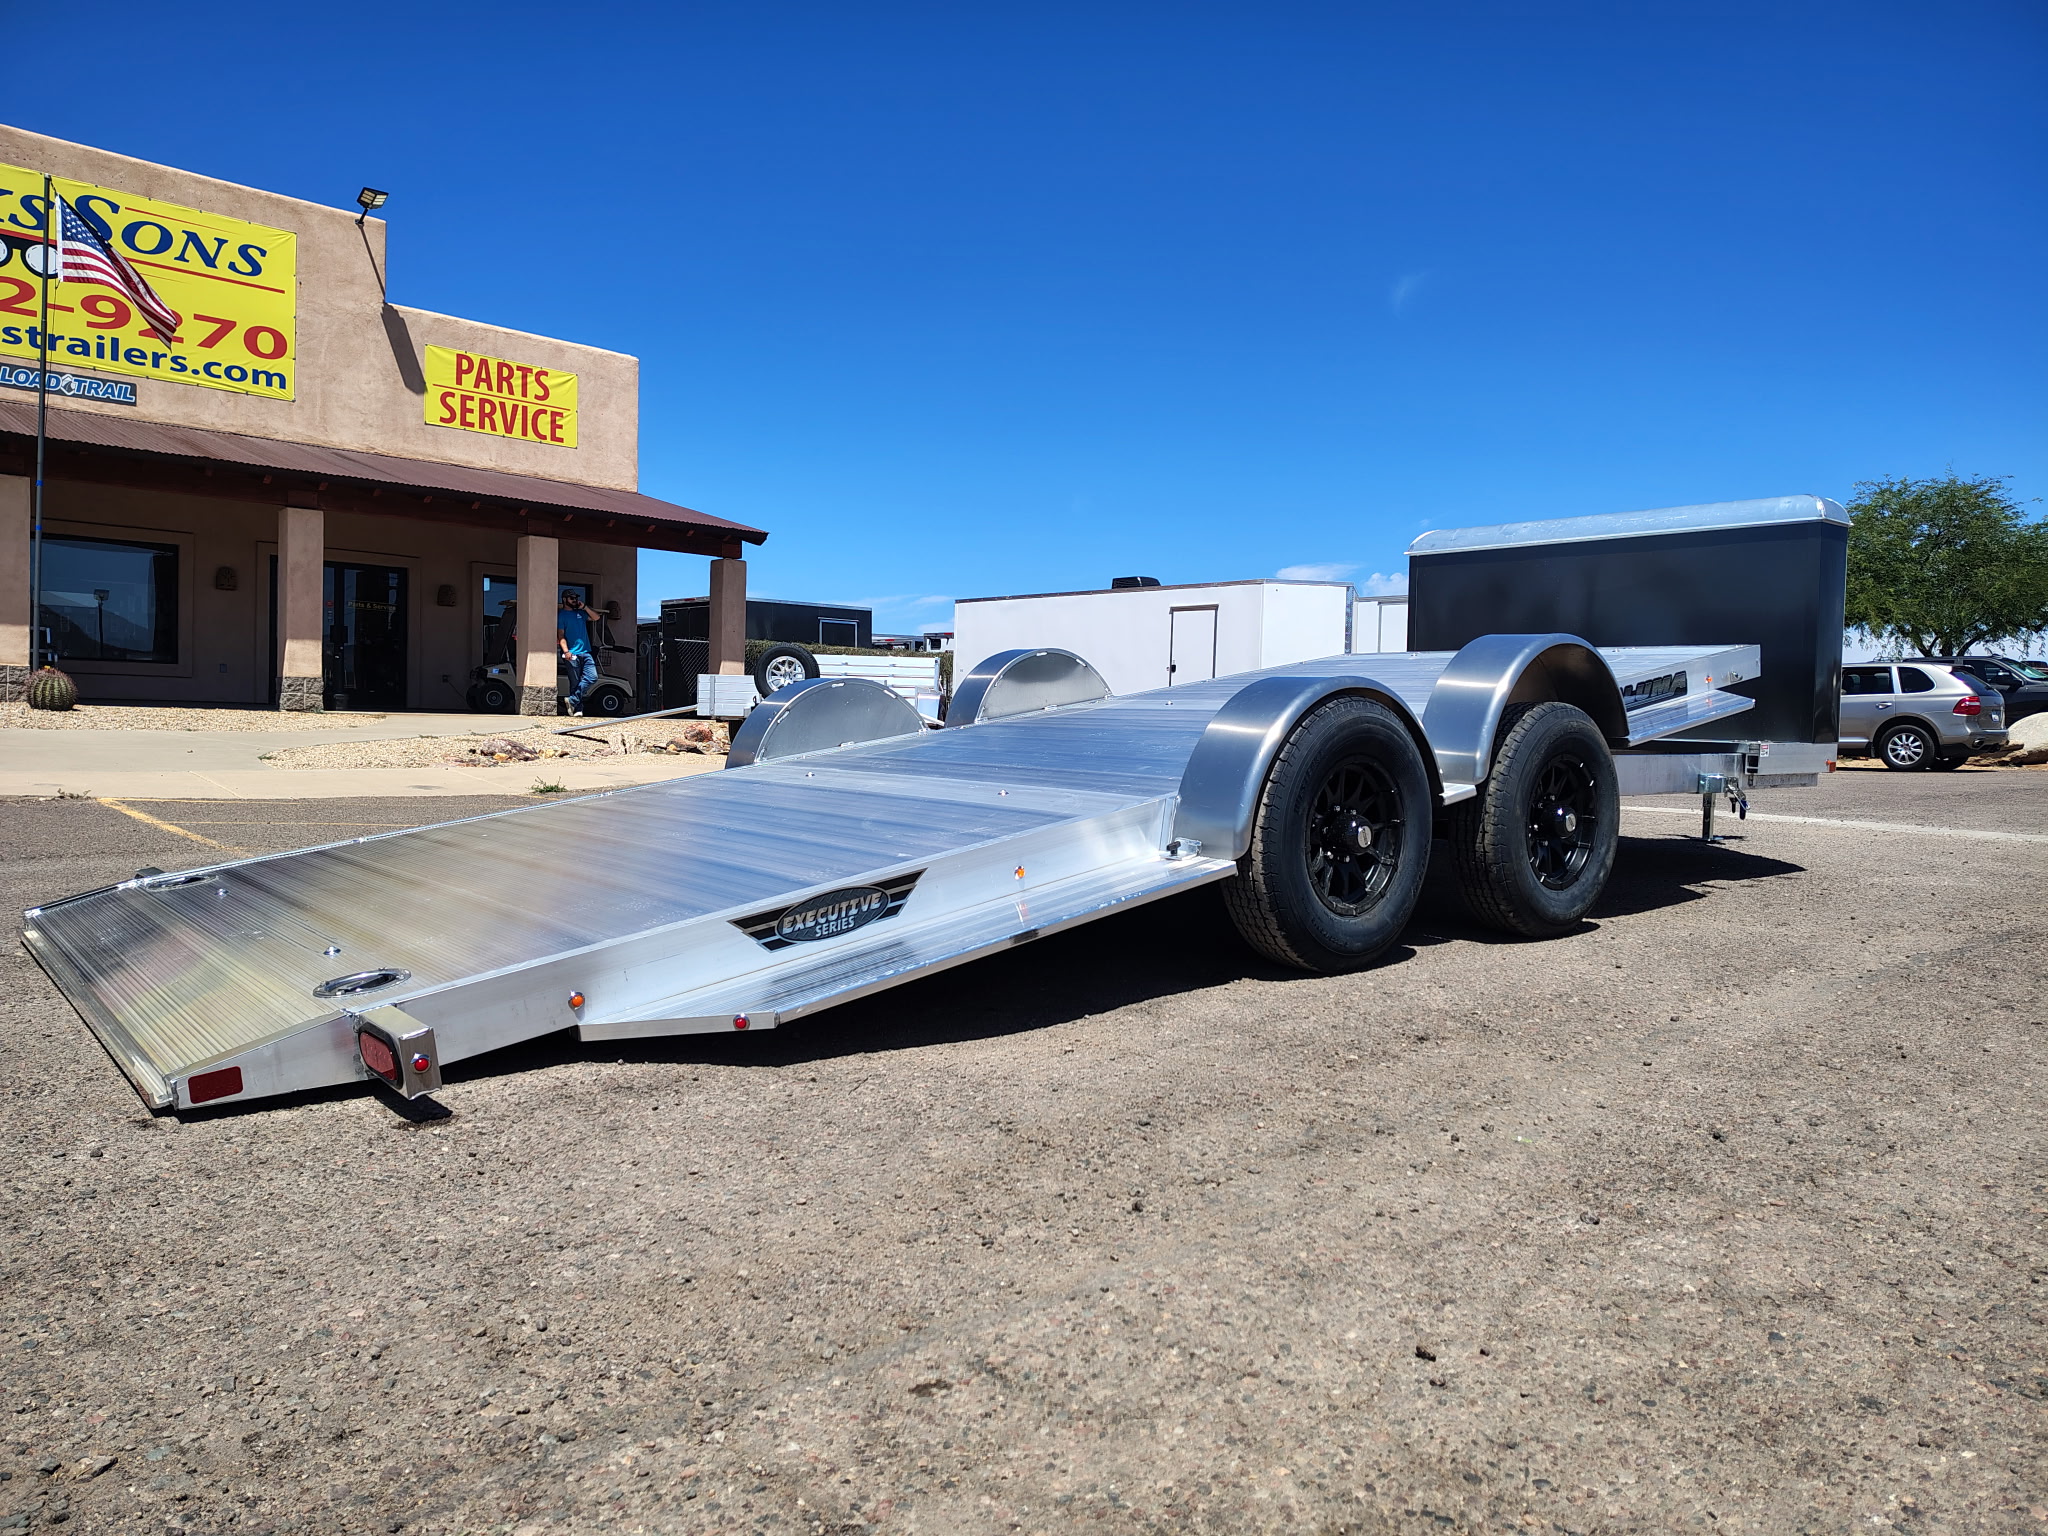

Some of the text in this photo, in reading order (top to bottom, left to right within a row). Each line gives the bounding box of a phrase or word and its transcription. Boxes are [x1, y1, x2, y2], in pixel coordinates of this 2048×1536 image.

[0, 187, 268, 277] S SONS
[1, 325, 287, 390] strailers.com
[455, 353, 550, 402] PARTS
[0, 366, 136, 403] LOAD TRAIL
[439, 391, 565, 444] SERVICE
[1620, 670, 1687, 704] LUMA
[781, 891, 884, 935] EXECUTIVE
[815, 916, 855, 938] SERIES
